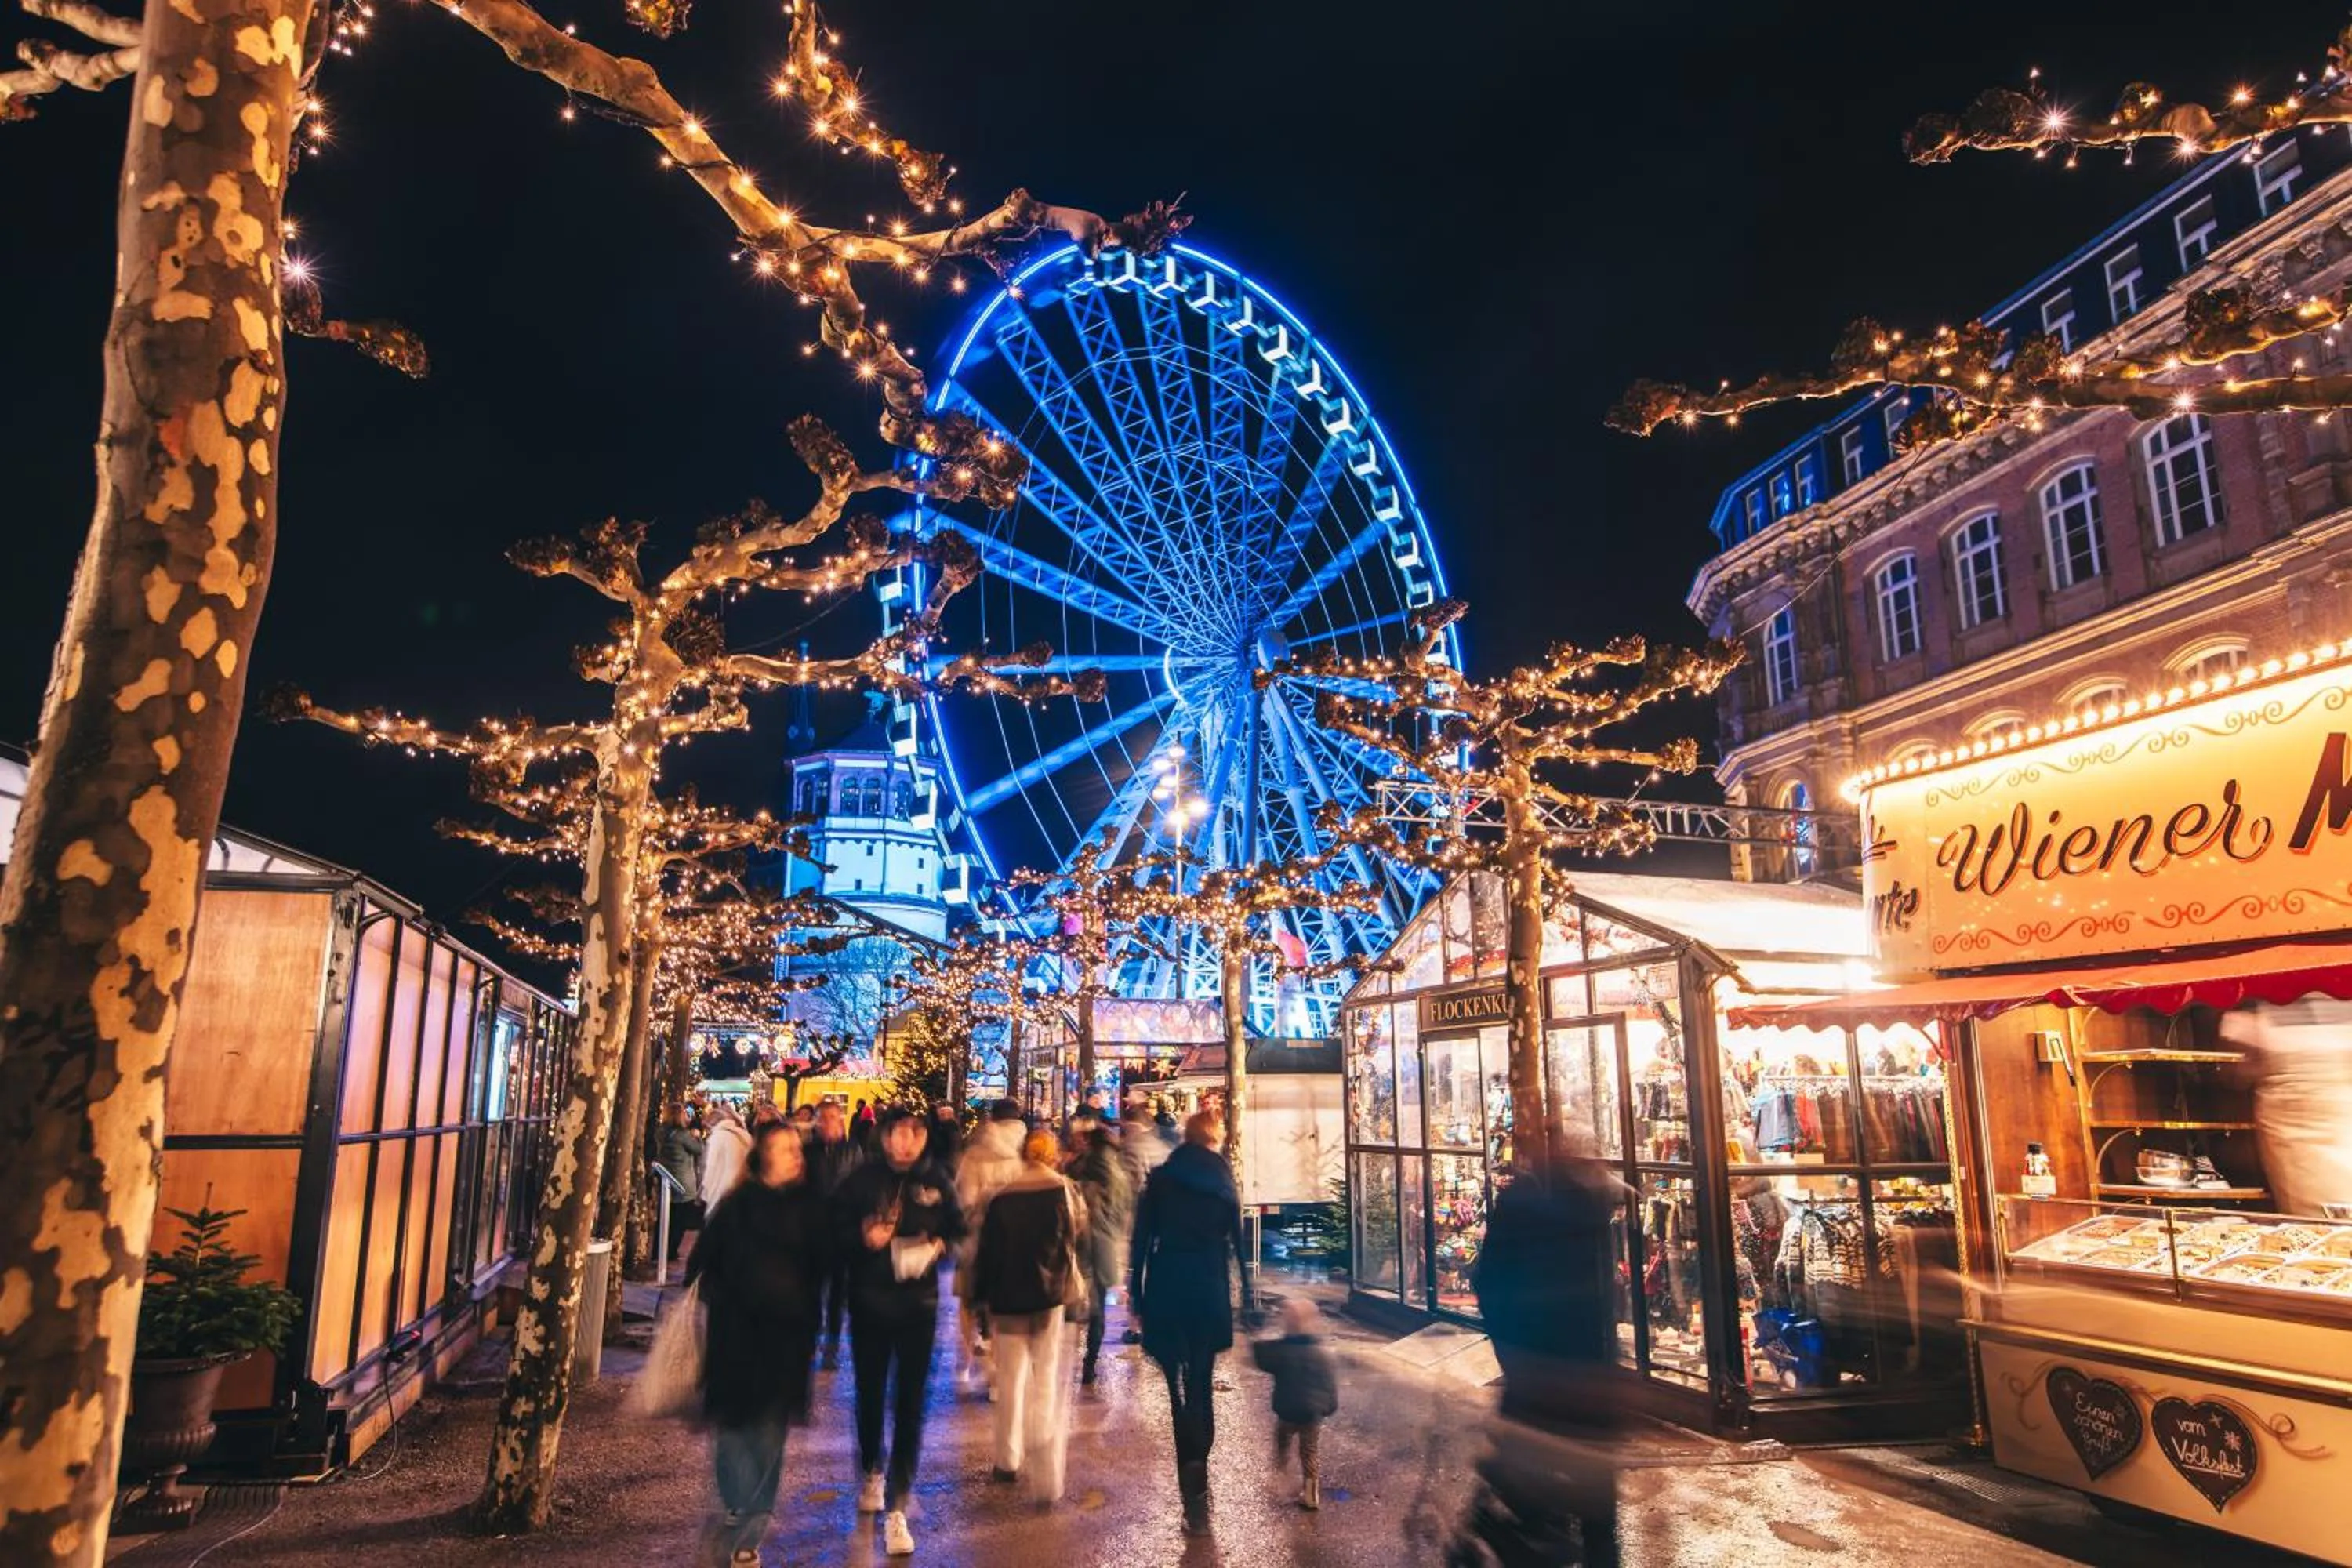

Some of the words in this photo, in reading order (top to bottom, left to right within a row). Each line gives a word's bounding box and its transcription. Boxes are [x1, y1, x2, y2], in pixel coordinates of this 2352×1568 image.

[1936, 779, 2273, 897] Wiener
[2176, 1418, 2207, 1438] vom
[2171, 1436, 2244, 1480] Volksfest
